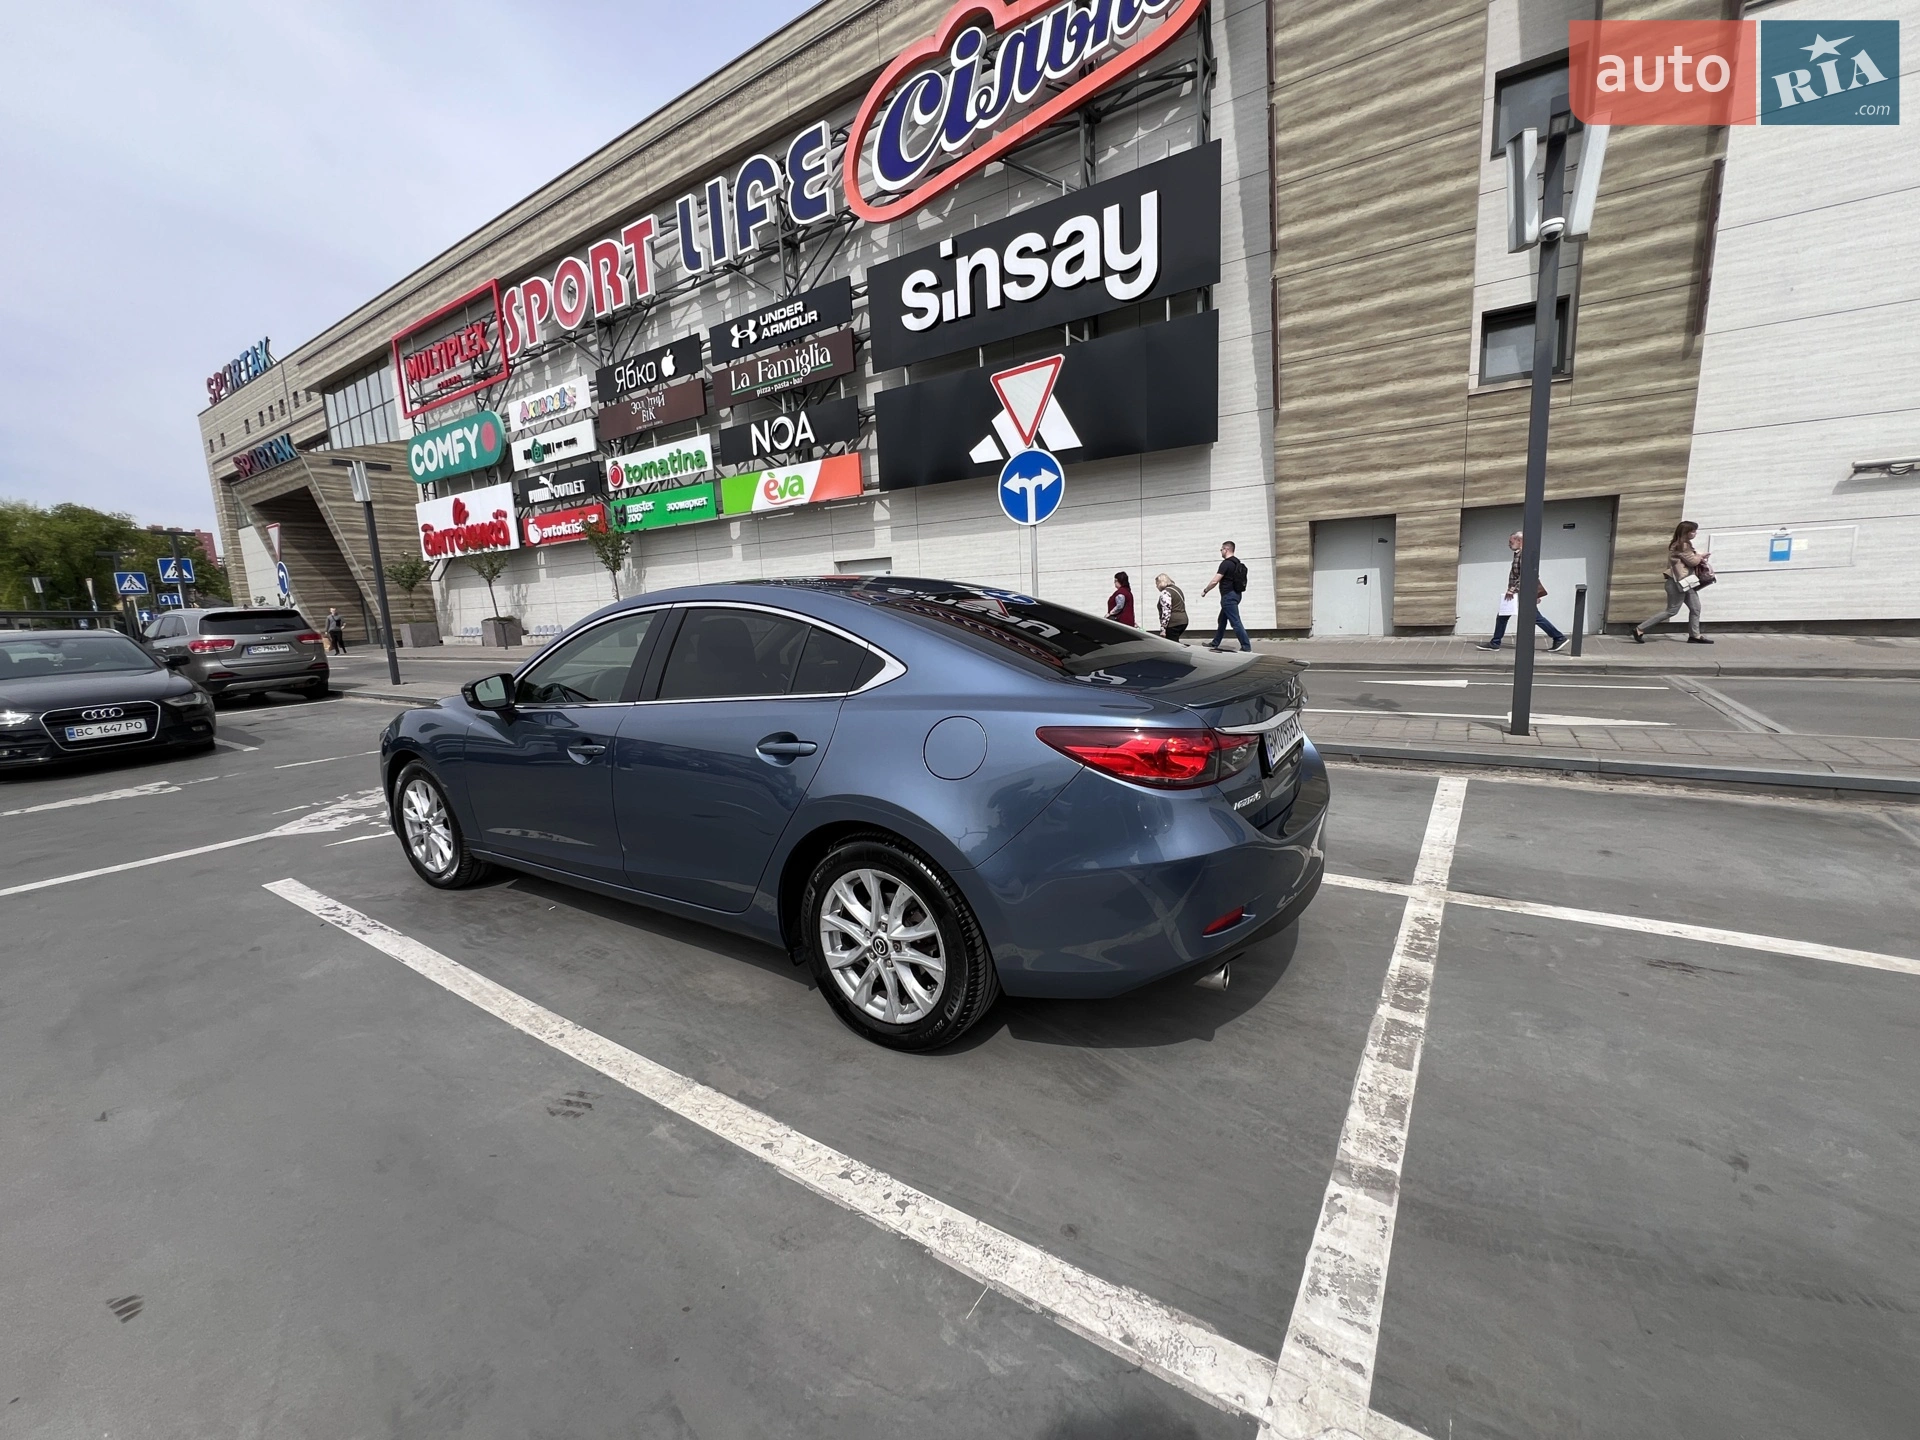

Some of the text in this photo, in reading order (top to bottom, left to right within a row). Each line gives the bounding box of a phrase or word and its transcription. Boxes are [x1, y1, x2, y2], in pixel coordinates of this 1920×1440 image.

[872, 0, 1168, 191] Сільп
[503, 119, 838, 358] SPORT LIFE
[900, 189, 1162, 332] sinsay
[759, 301, 804, 326] UNDER
[761, 310, 818, 339] ARMOUR
[405, 322, 490, 385] MULTIPLEX
[730, 343, 831, 391] La Famiglia
[614, 359, 657, 393] Ябко
[756, 385, 771, 397] pizza
[774, 381, 790, 392] pasta
[410, 423, 480, 477] COMFY
[750, 410, 816, 456] NOA
[624, 448, 708, 484] tomatina
[553, 479, 586, 498] OUTLET
[626, 501, 656, 514] master
[75, 721, 142, 737] BC 1647 PO
